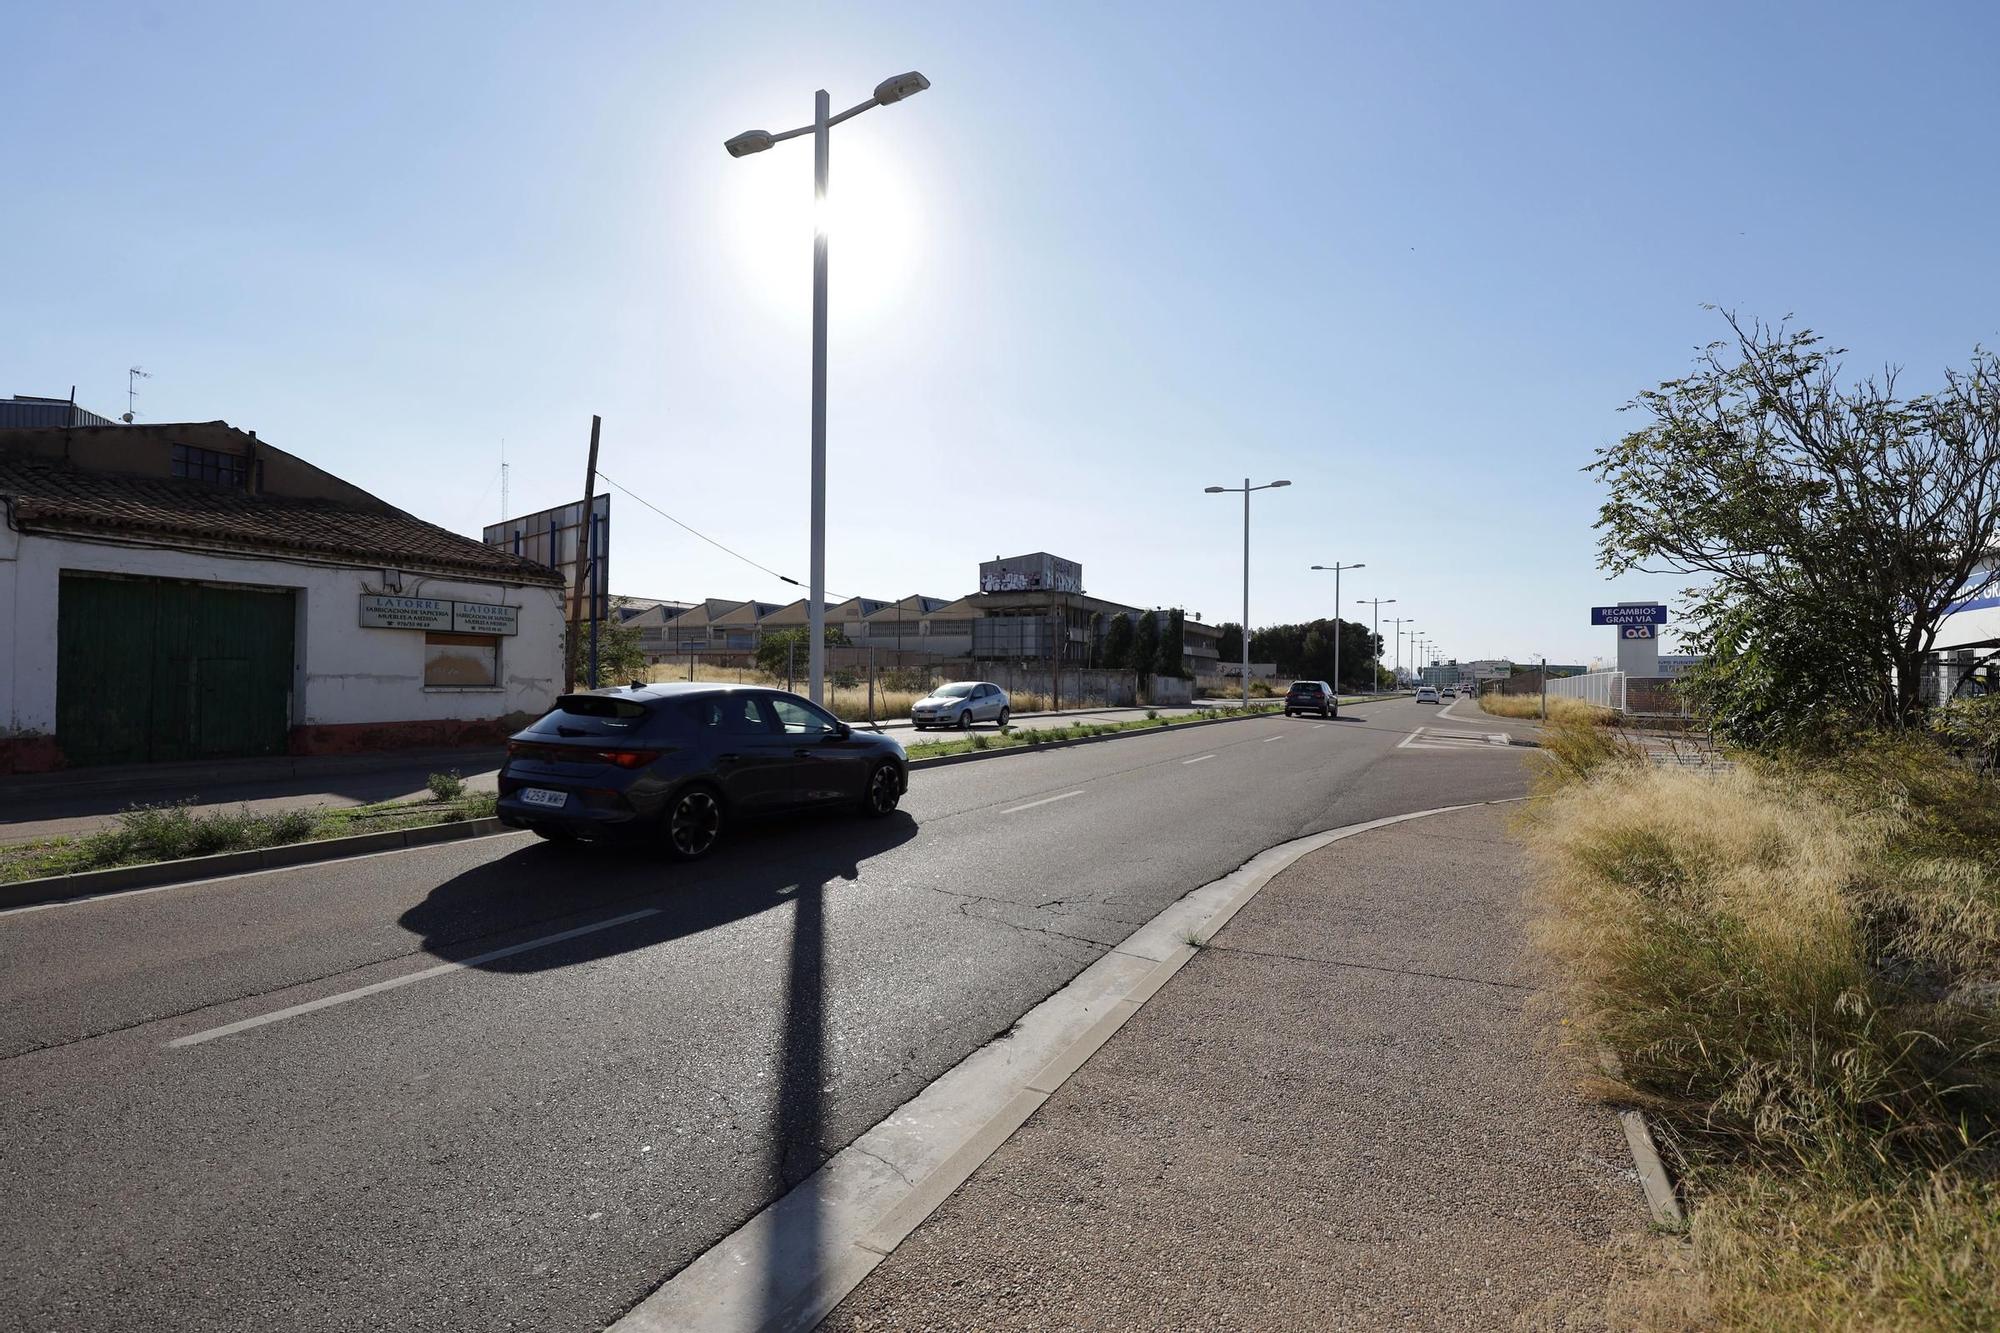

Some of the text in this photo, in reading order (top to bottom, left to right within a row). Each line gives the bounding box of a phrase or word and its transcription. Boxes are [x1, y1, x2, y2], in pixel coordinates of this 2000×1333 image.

[376, 599, 441, 609] LATORRE
[463, 605, 509, 615] LATORRE
[1602, 607, 1656, 616] RECAMBIOS
[1636, 615, 1653, 623] VIA
